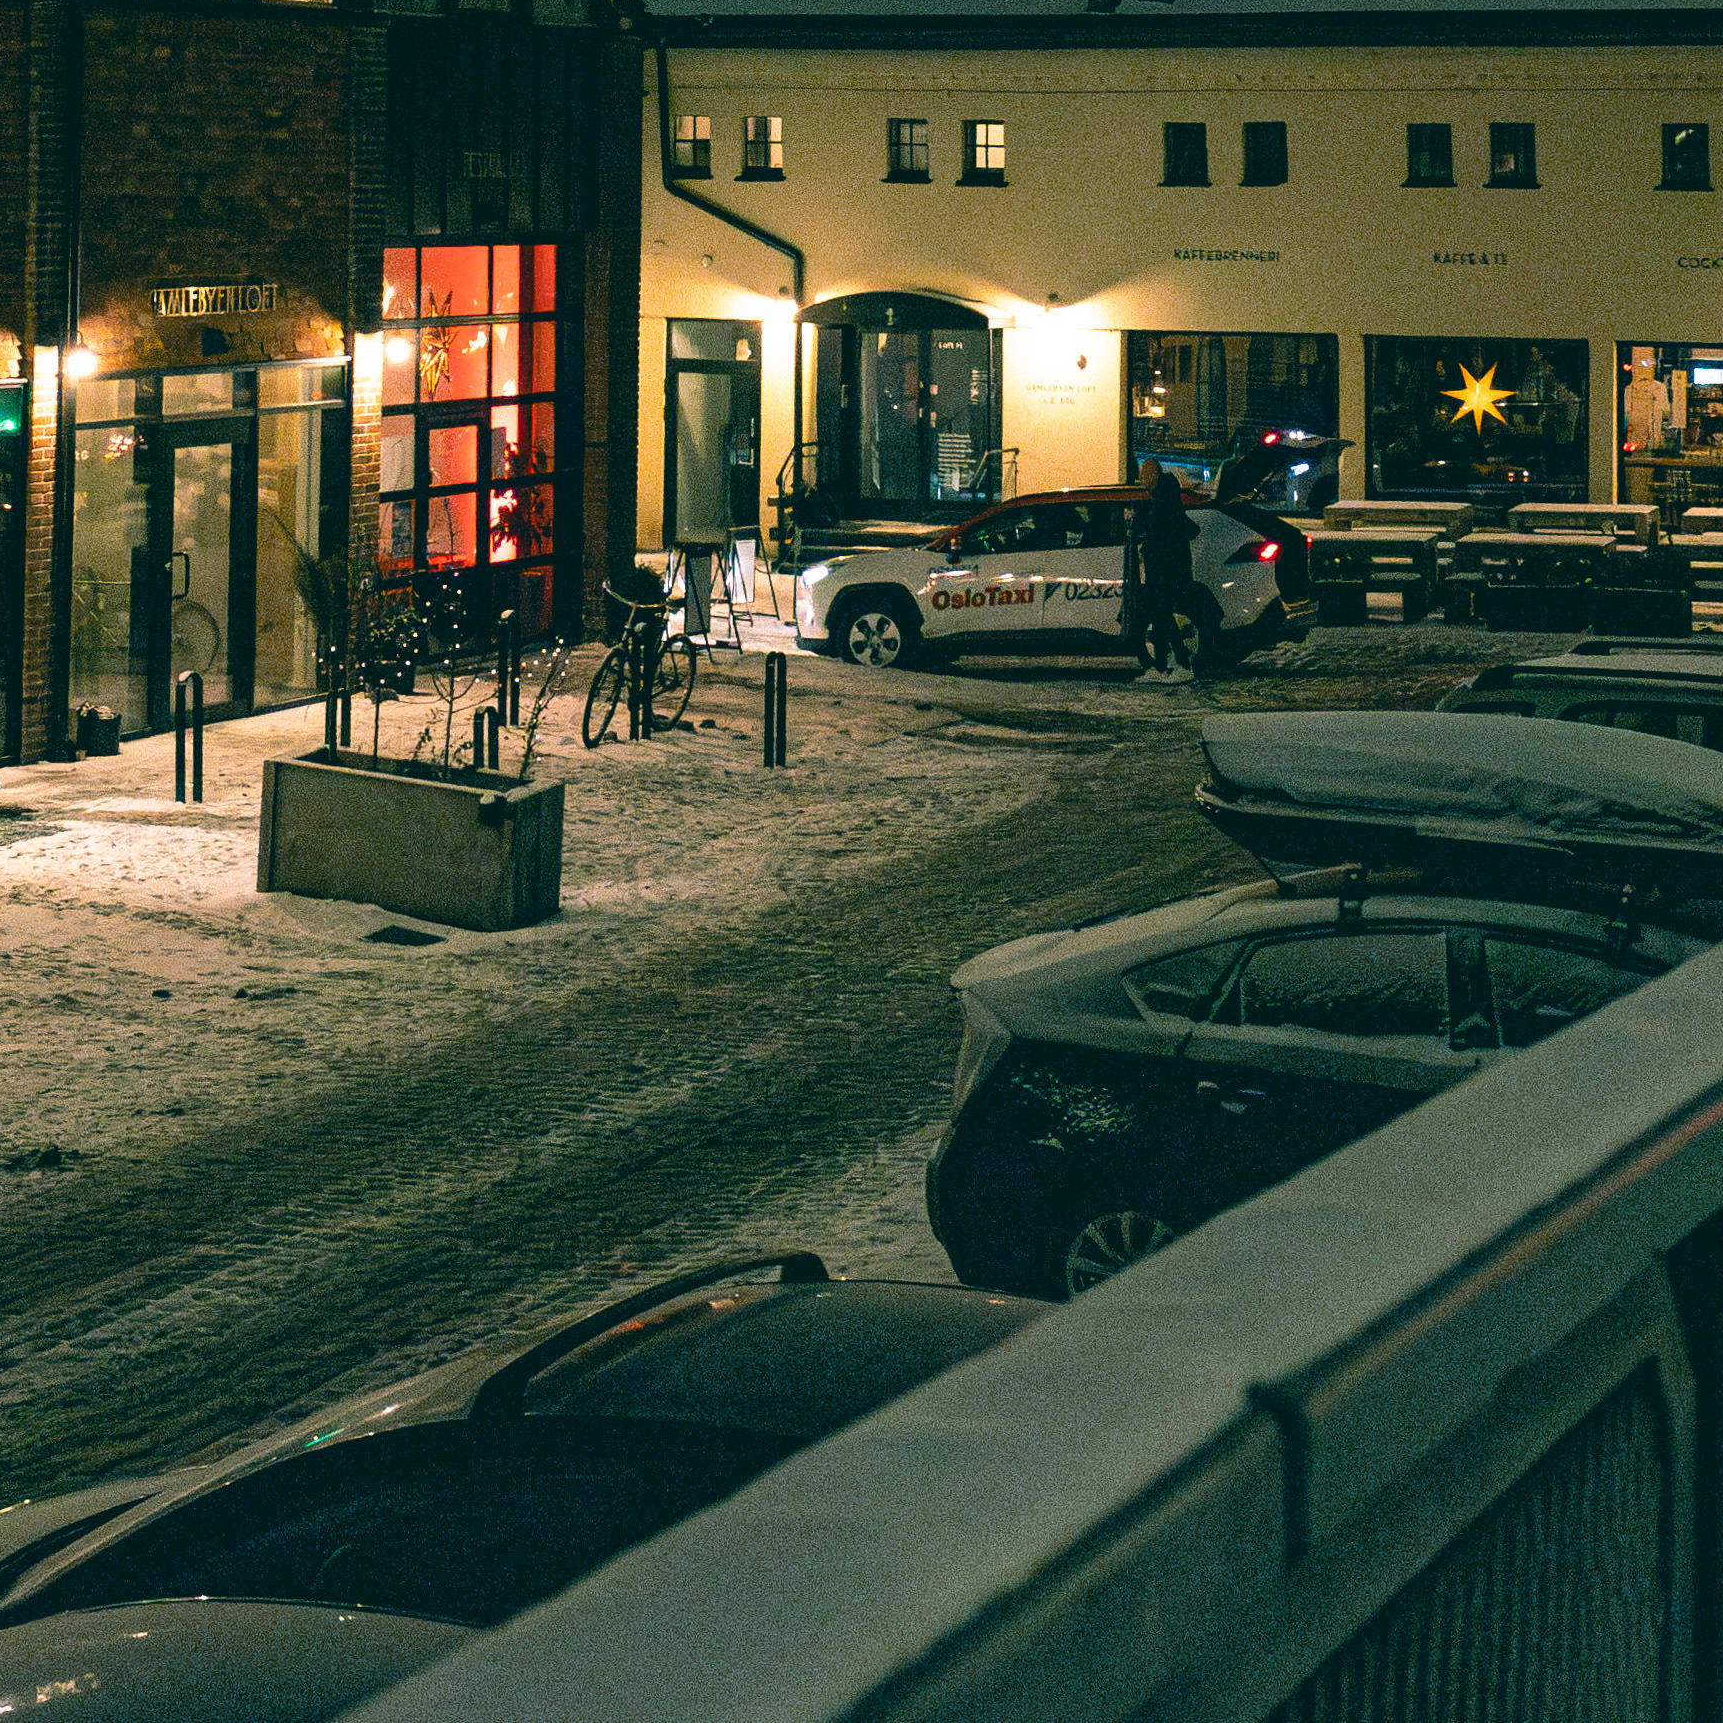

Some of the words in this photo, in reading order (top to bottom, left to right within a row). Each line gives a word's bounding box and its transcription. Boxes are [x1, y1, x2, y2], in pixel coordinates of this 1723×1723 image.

[1173, 247, 1281, 262] KAFFEBRENNERI
[1432, 251, 1476, 266] KAFFE
[931, 584, 1035, 611] OsloTaxi
